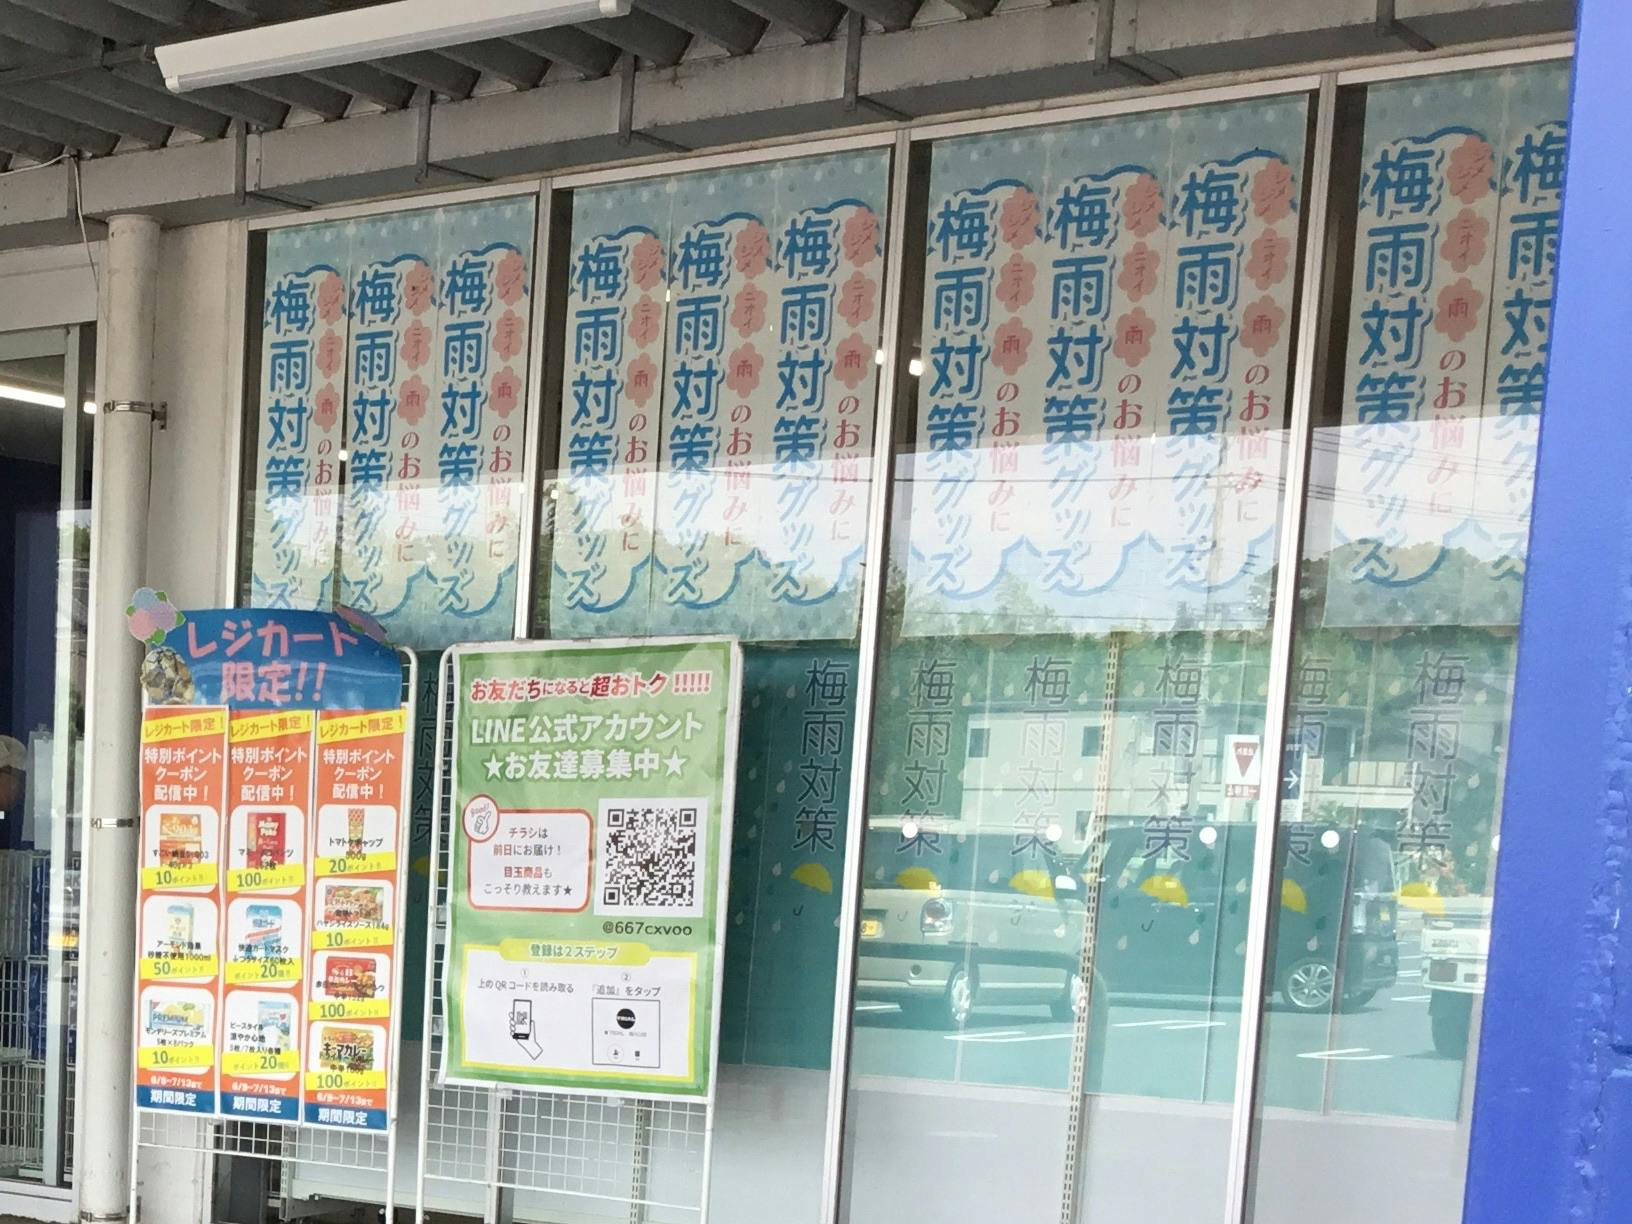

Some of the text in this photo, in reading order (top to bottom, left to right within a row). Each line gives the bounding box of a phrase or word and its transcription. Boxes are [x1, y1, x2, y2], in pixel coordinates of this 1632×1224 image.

[1447, 298, 1468, 322] 雨
[1125, 324, 1143, 347] 雨
[1252, 313, 1272, 336] 雨
[1002, 335, 1020, 357] 雨
[737, 359, 753, 379] 雨
[843, 348, 861, 370] 雨
[1352, 147, 1435, 580] 梅雨対策グッズ
[633, 369, 648, 389] 雨
[1041, 184, 1110, 588] 梅雨対策グッズ
[1167, 169, 1239, 583] 梅雨対策グッズ
[406, 390, 420, 407] 雨
[498, 382, 512, 400] 雨
[927, 197, 990, 589] 梅雨対策グッズ
[321, 398, 334, 416] 雨
[668, 229, 724, 602] 梅雨対策グッズ
[771, 216, 833, 598] 梅雨対策グッズ
[438, 257, 487, 611] 梅雨対策グッズ
[568, 244, 622, 604] 梅雨対策グッズ
[265, 275, 310, 610] 梅雨対策グッズ
[349, 270, 395, 612] 梅雨対策グッズ
[187, 619, 359, 658] レジカート
[470, 711, 704, 745] LINE公式アカウント
[144, 746, 222, 764] 特別ポイント
[231, 746, 308, 764] 特別ポイント
[323, 750, 395, 766] 特別ポイント
[792, 659, 850, 852] 梅雨対策
[895, 659, 958, 856] 梅雨対策
[1010, 656, 1073, 858] 梅雨対策
[1142, 655, 1203, 862] 梅雨対策
[155, 765, 207, 781] クーポン
[242, 765, 294, 781] クーポン
[334, 767, 383, 781] クーポン
[508, 826, 549, 839] チラシは
[503, 866, 553, 879] 目玉商品も
[602, 921, 693, 937] @667cxvoo
[530, 943, 618, 960] 登録は2ステップ
[477, 978, 575, 994] 上のQRコードを読み取る
[150, 1090, 197, 1107] 期間限定
[232, 1096, 282, 1114] 期間限定
[318, 1108, 368, 1126] 期間限定
